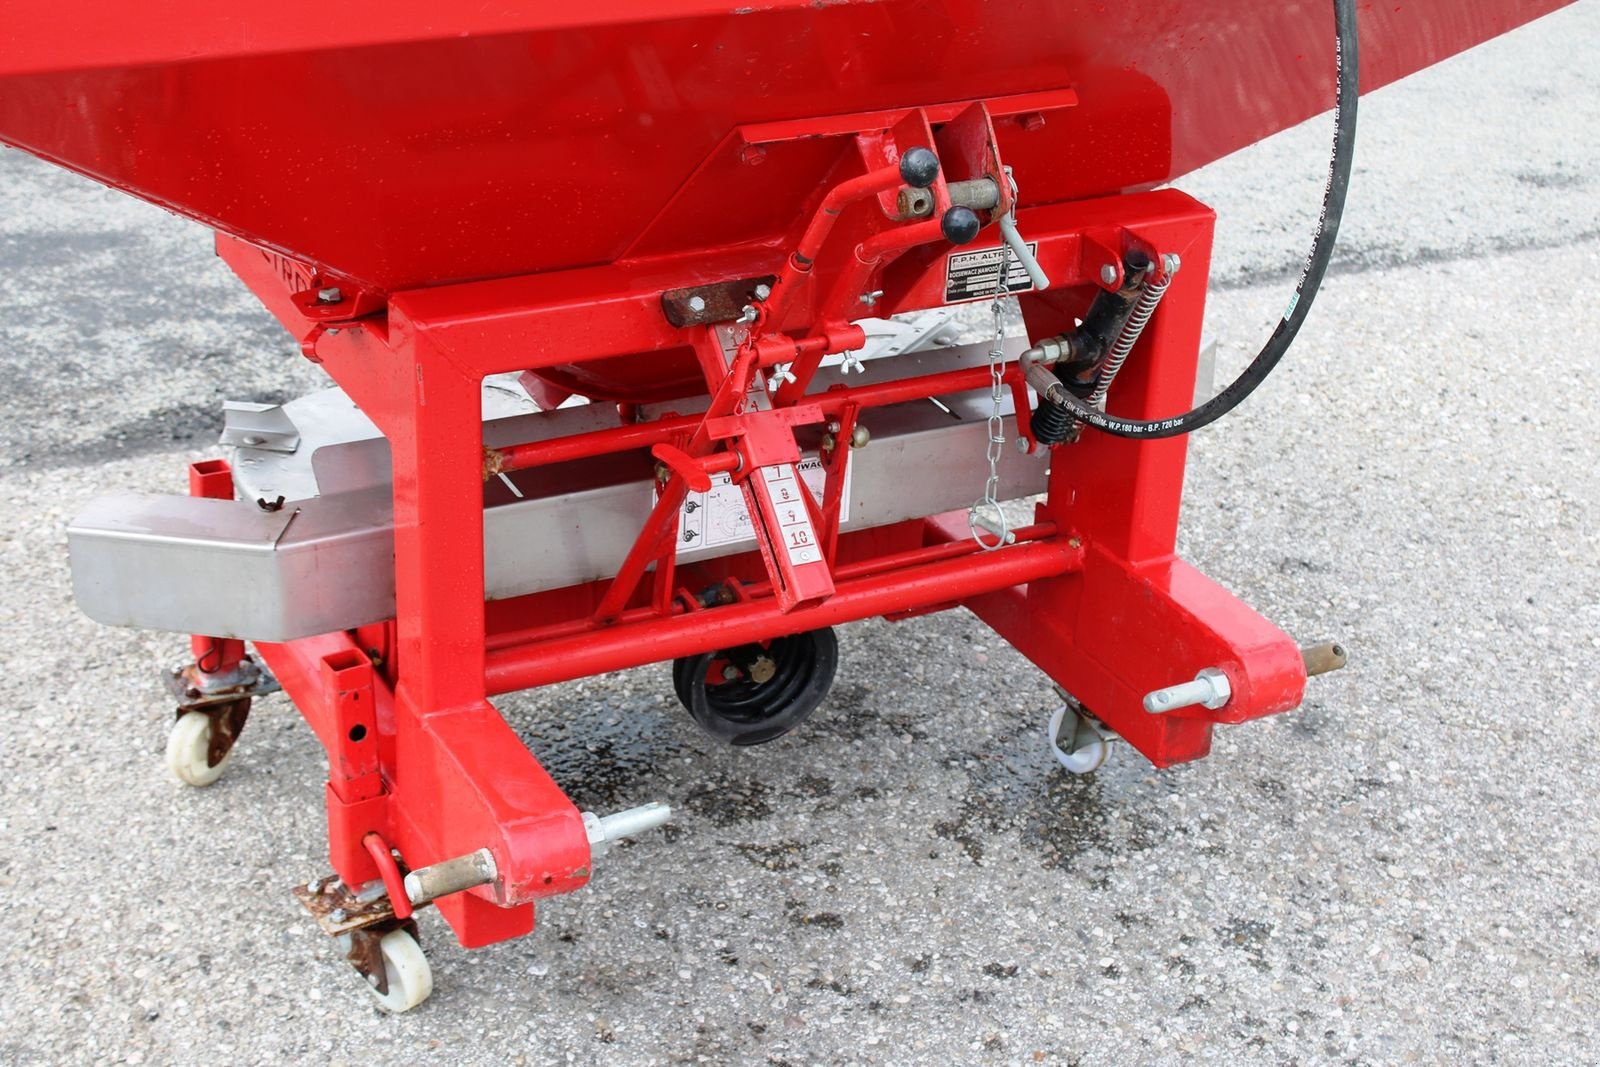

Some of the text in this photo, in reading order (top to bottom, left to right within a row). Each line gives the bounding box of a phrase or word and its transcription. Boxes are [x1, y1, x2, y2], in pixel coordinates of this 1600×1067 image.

[1132, 424, 1144, 433] bar
[1147, 423, 1161, 433] B.P.
[1161, 420, 1173, 430] 720
[1173, 417, 1184, 427] bar
[772, 466, 781, 478] 7
[780, 488, 790, 500] 8
[788, 510, 796, 522] 9
[791, 530, 808, 546] 10
